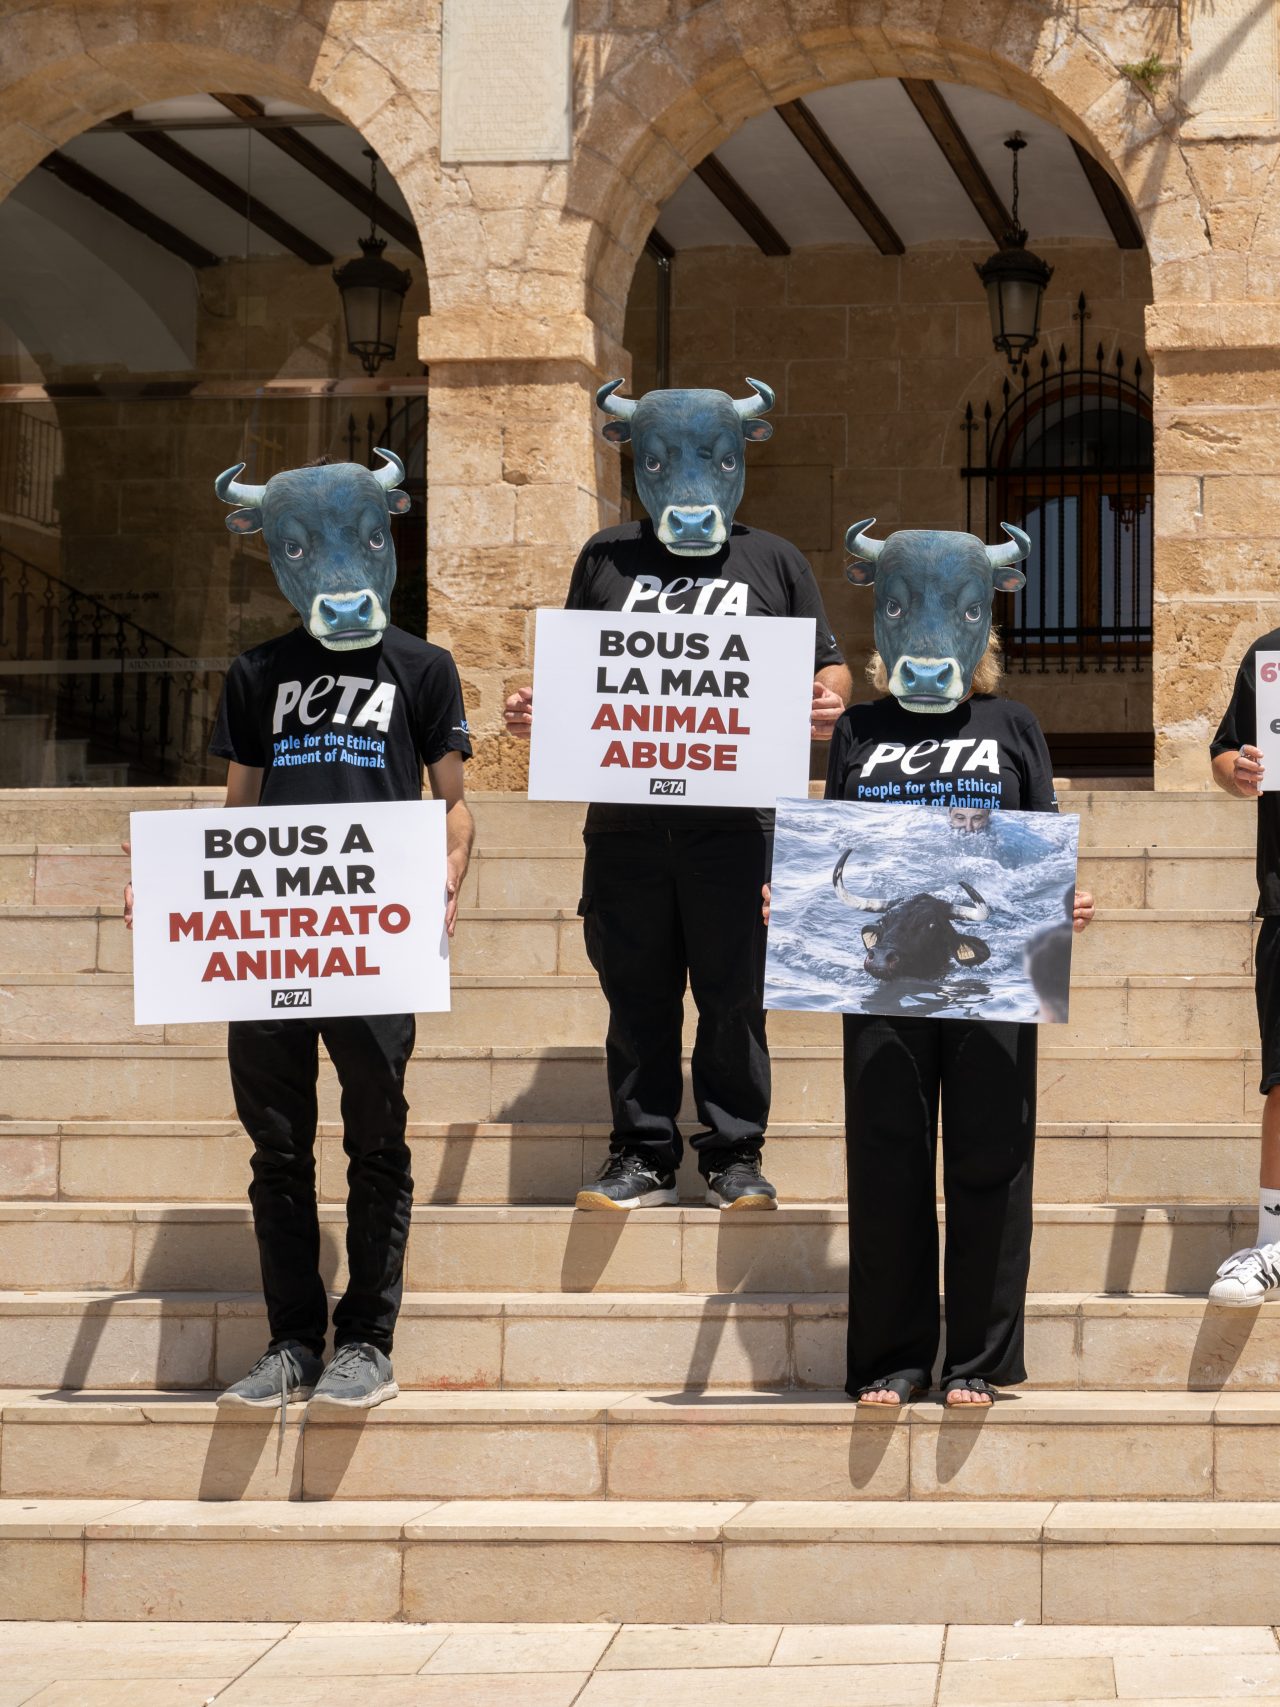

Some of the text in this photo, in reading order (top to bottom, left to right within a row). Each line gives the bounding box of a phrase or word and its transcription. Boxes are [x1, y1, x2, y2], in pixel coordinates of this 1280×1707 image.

[599, 630, 750, 661] BOUS A
[596, 666, 750, 698] LA MAR
[590, 703, 751, 735] ANIMAL
[273, 748, 386, 769] eatment of Animals
[304, 733, 322, 748] for
[324, 731, 344, 747] the
[347, 734, 386, 754] Ethical
[599, 740, 738, 772] ABUSE
[858, 778, 1002, 798] People for the Ethical
[949, 794, 1001, 809] Animals
[204, 824, 374, 859] BOUS A
[203, 864, 376, 900] LA MAR
[168, 903, 411, 942] MALTRATO
[201, 946, 381, 982] ANIMAL
